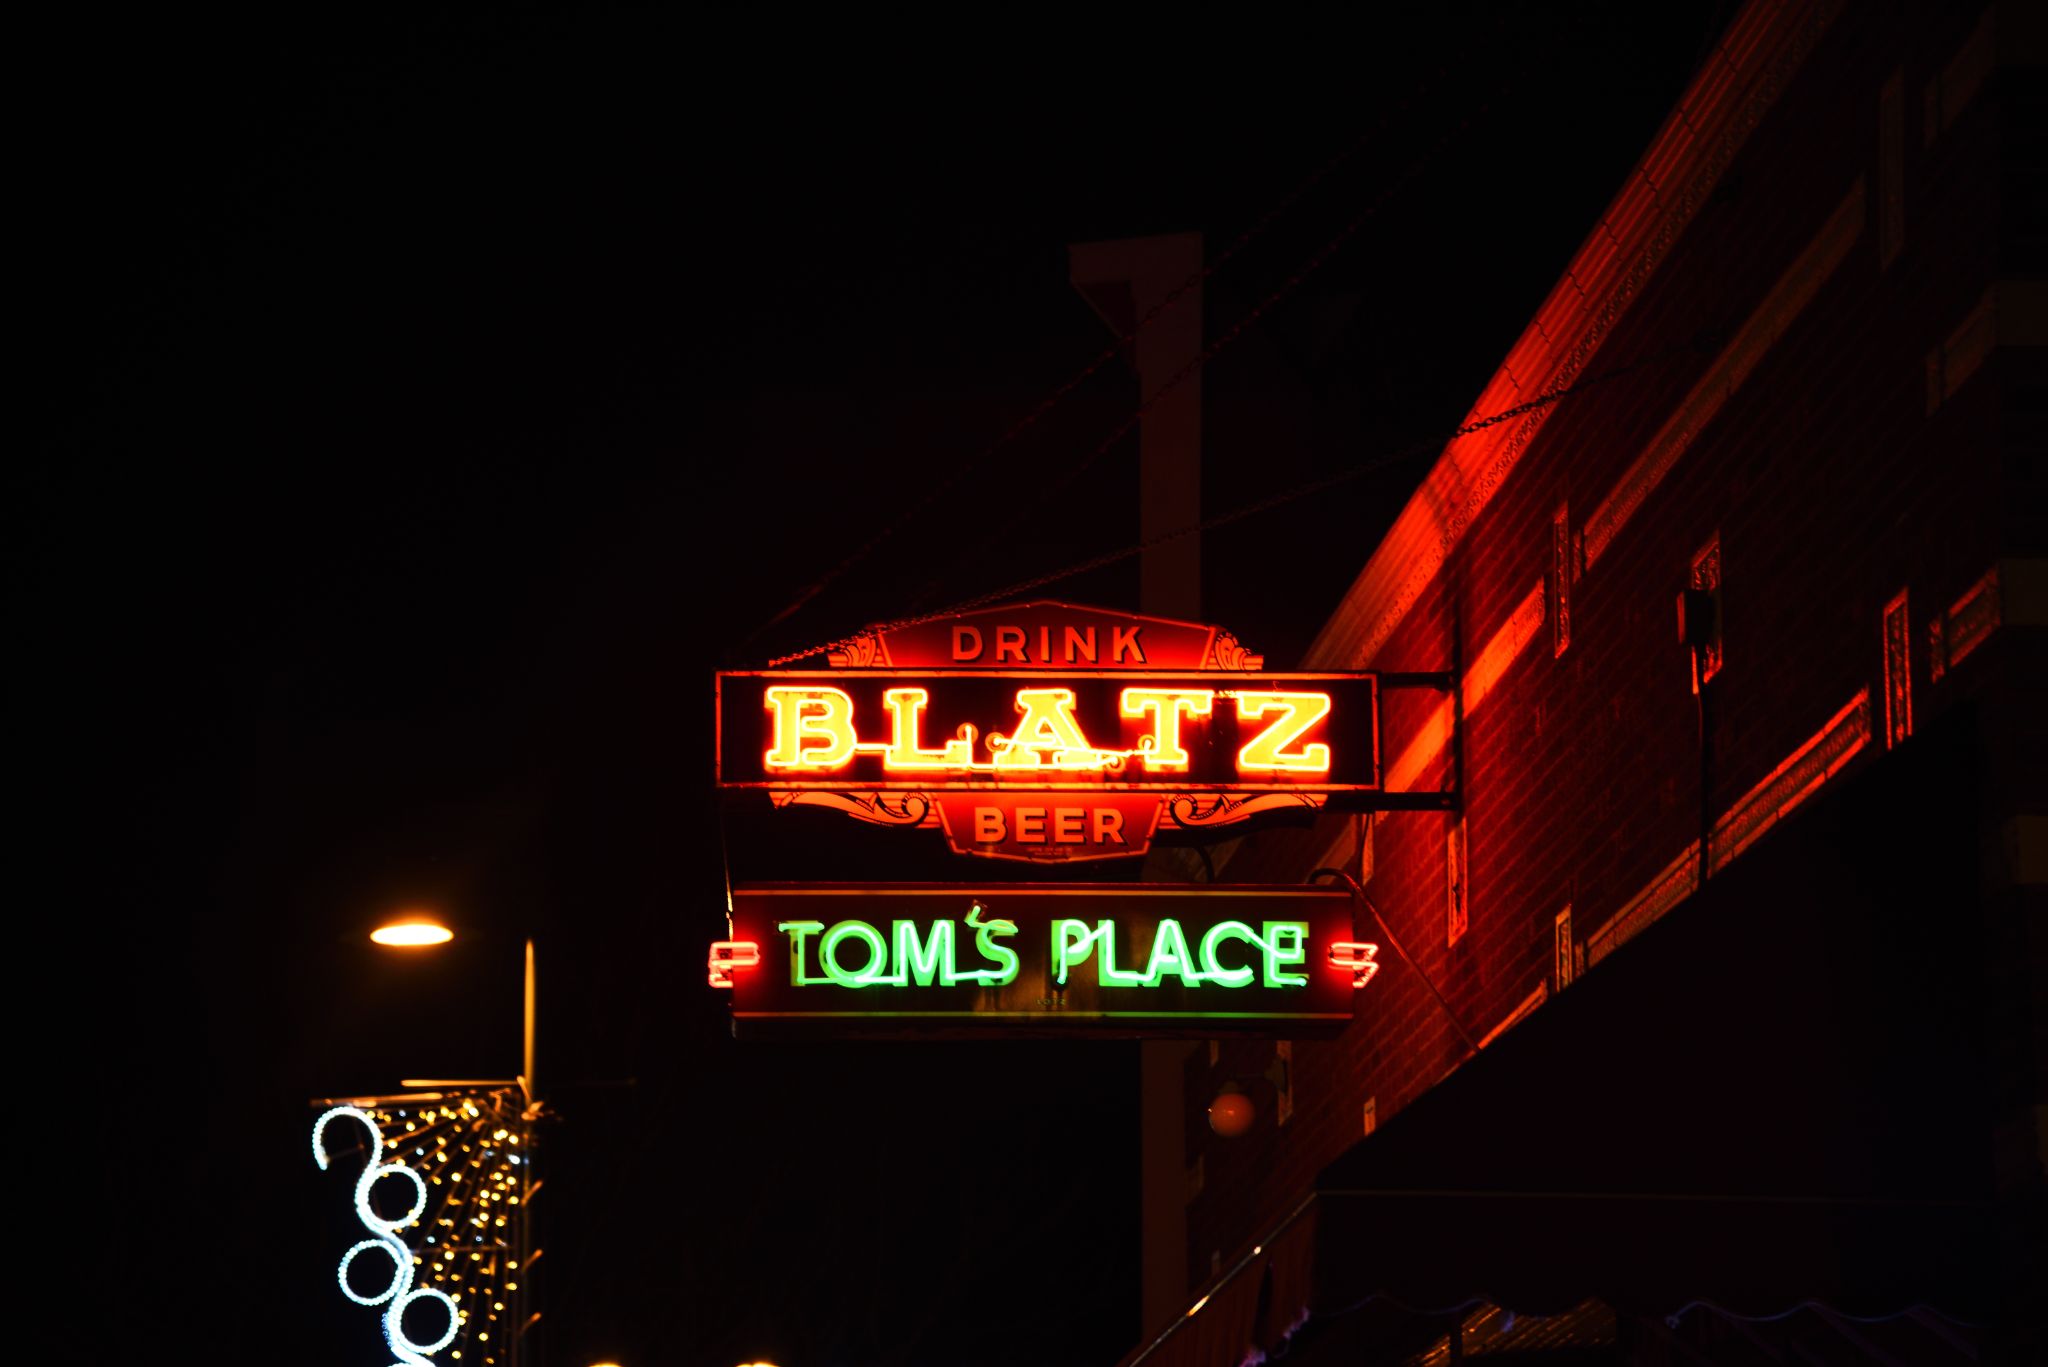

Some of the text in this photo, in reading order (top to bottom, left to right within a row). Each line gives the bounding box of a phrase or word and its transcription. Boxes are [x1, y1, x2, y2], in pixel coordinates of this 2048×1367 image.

[952, 626, 1147, 663] DRINK
[764, 687, 1333, 772] BLATZ
[974, 807, 1128, 844] BEER
[778, 904, 1310, 988] TOM'S PLACE
